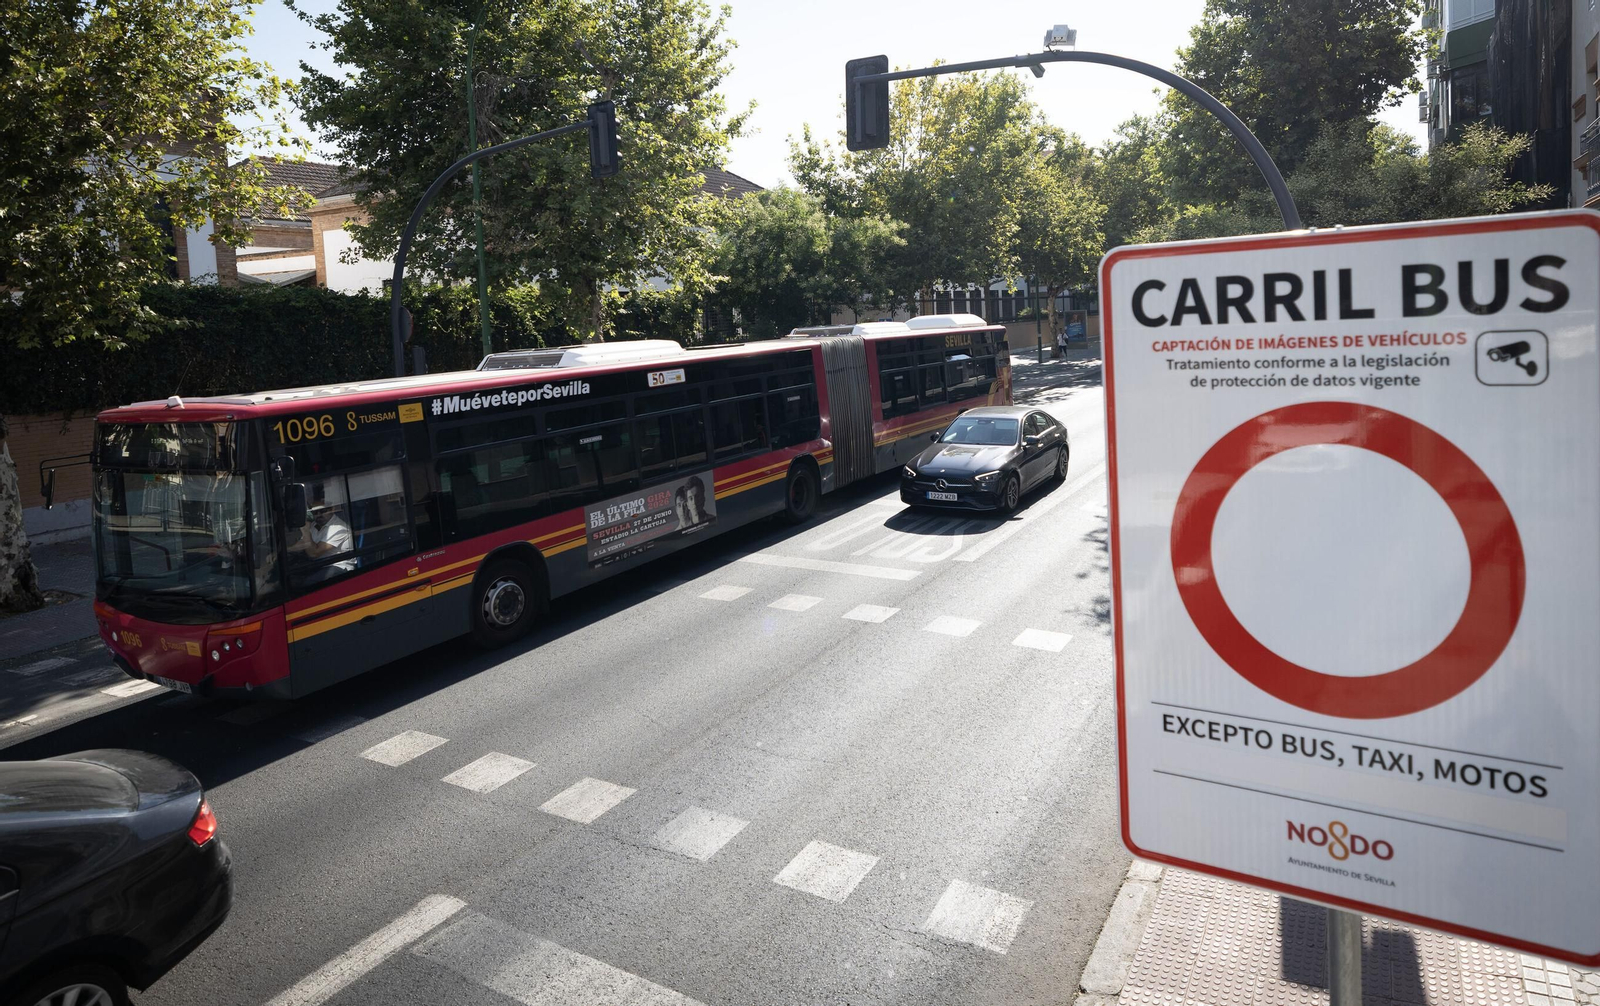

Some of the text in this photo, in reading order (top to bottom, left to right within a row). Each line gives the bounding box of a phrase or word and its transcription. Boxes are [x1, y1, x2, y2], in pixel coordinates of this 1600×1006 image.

[1131, 254, 1570, 328] CARRIL BUS
[945, 334, 972, 348] SEVILLA
[1152, 329, 1467, 353] CAPTACIÓN DE IMÁGENES DE VEHÍCULOS
[1166, 352, 1450, 371] Tratamiento conforme a la legislación
[651, 372, 665, 386] 50
[1190, 373, 1421, 391] de protección de datos vigente
[431, 380, 591, 417] #MuéveteporSevilla
[273, 414, 335, 444] 1096
[359, 411, 396, 424] TUSSAM
[590, 490, 672, 521] EL ÚLTIMO GIRA
[590, 498, 670, 529] DE LA FILA 2026
[593, 522, 631, 540] SEVILLA
[643, 516, 652, 524] DE
[653, 509, 672, 520] JUNIO
[600, 532, 629, 545] ESTADIO
[640, 519, 667, 532] CARTUJA
[607, 542, 625, 552] VENTA
[120, 630, 142, 648] 1096
[1162, 714, 1549, 799] EXCEPTO BUS, TAXI, MOTOS
